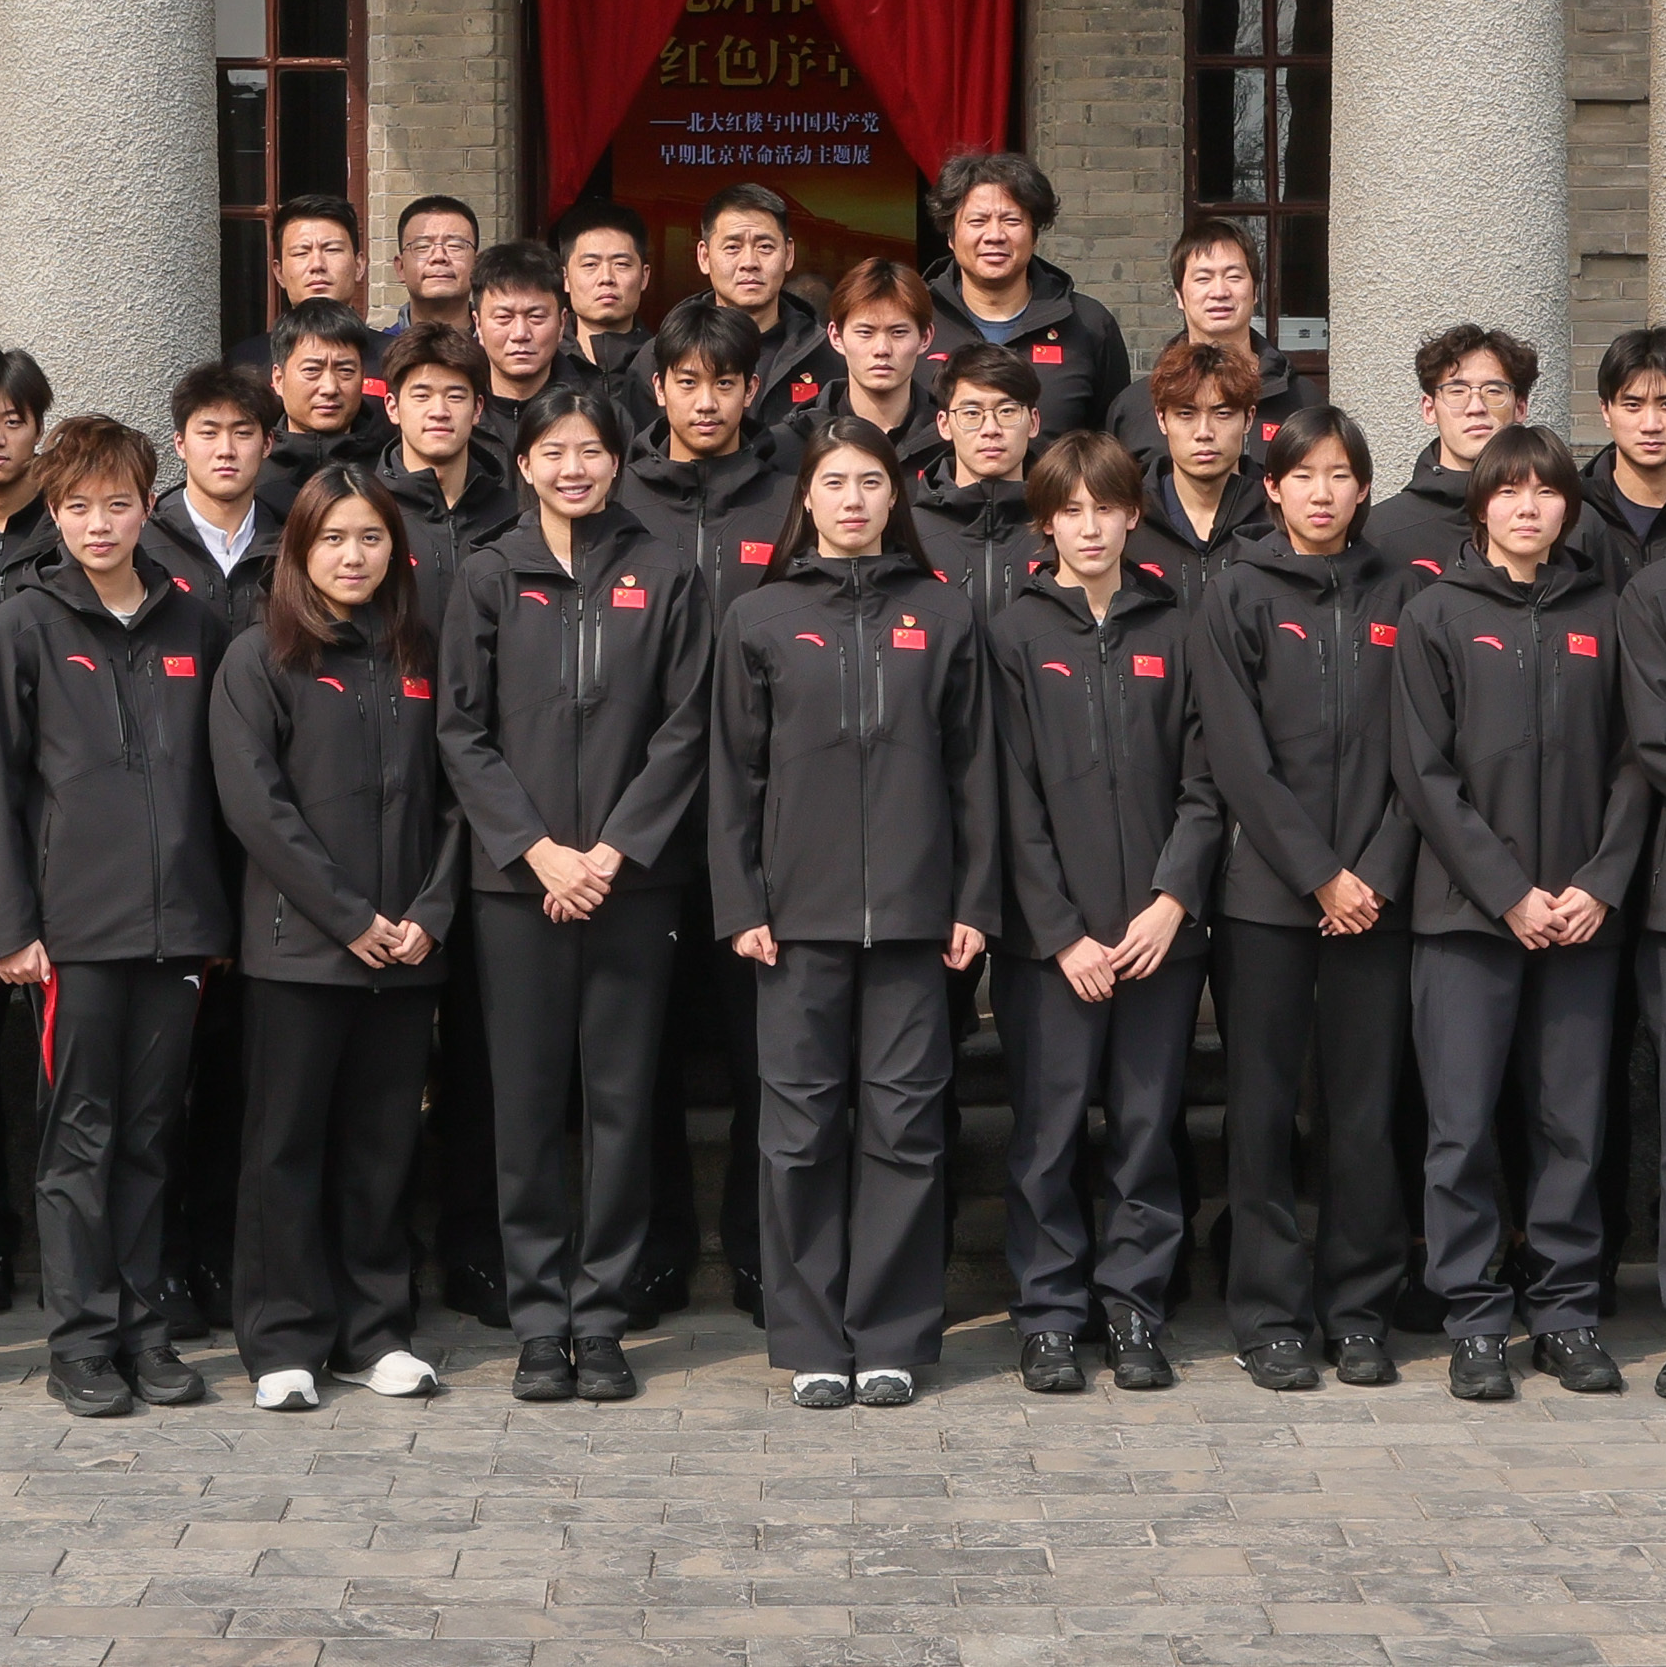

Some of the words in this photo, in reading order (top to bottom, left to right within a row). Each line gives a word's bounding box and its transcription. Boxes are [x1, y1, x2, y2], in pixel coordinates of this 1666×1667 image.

[659, 144, 871, 166] 早期北京革命活动主题展
